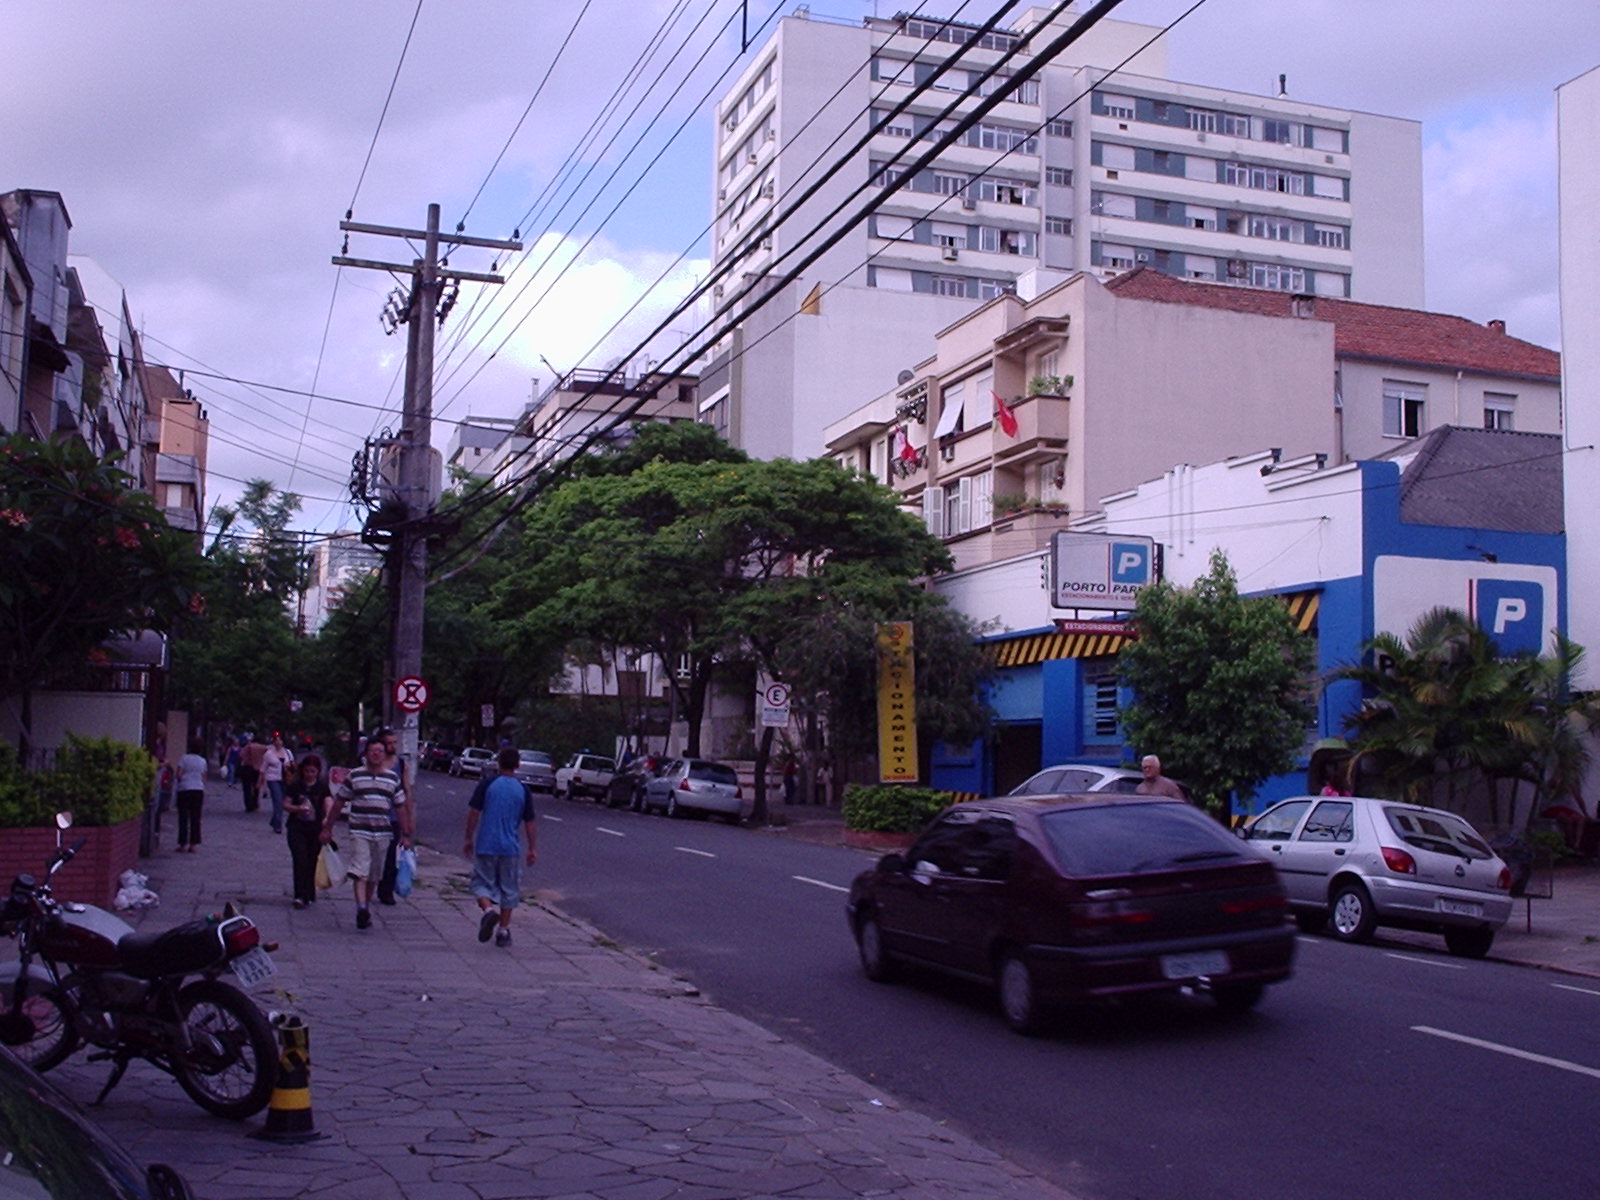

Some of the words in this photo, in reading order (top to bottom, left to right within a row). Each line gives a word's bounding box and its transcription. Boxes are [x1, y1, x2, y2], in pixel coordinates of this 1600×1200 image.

[1117, 552, 1142, 574] P
[1062, 582, 1106, 593] PORTO
[1493, 598, 1527, 634] P
[773, 690, 781, 702] E
